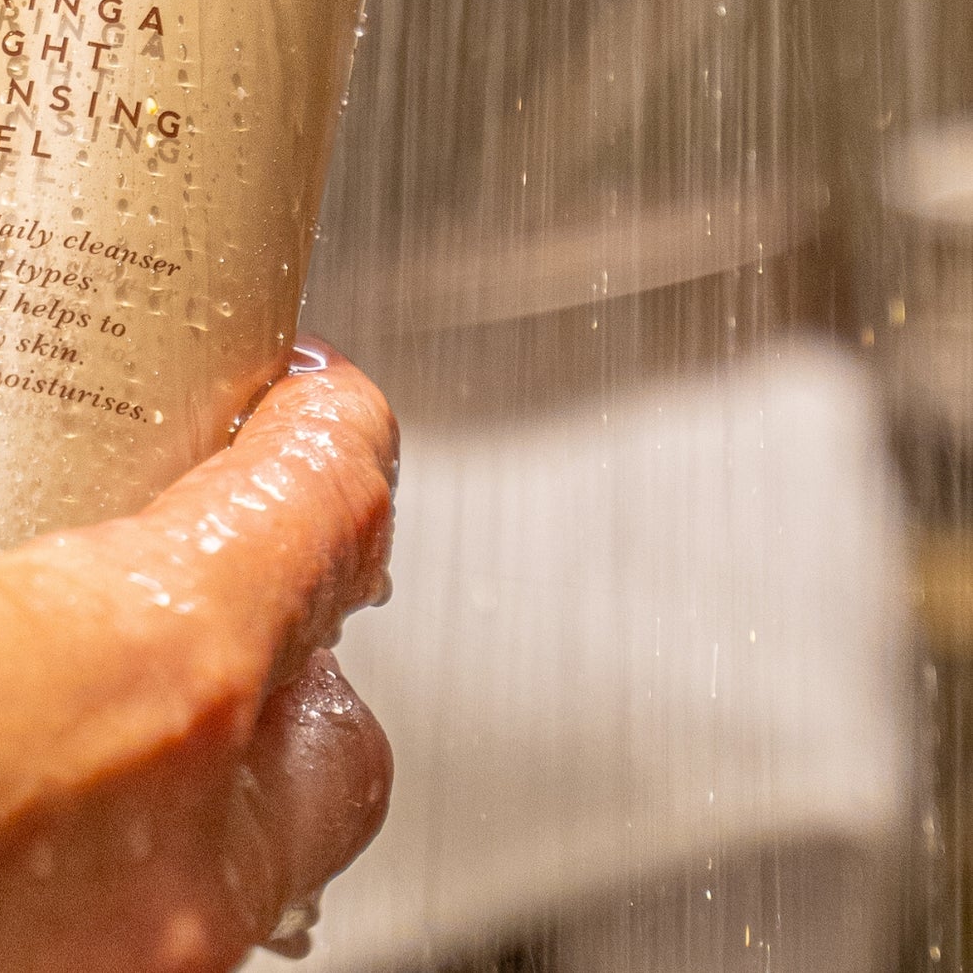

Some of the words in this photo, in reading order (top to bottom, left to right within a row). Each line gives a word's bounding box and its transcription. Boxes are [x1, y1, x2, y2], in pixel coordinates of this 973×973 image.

[63, 230, 182, 277] cleanser
[15, 258, 98, 293] types.
[13, 292, 92, 329] helps
[100, 315, 127, 338] to
[15, 333, 85, 366] skin.
